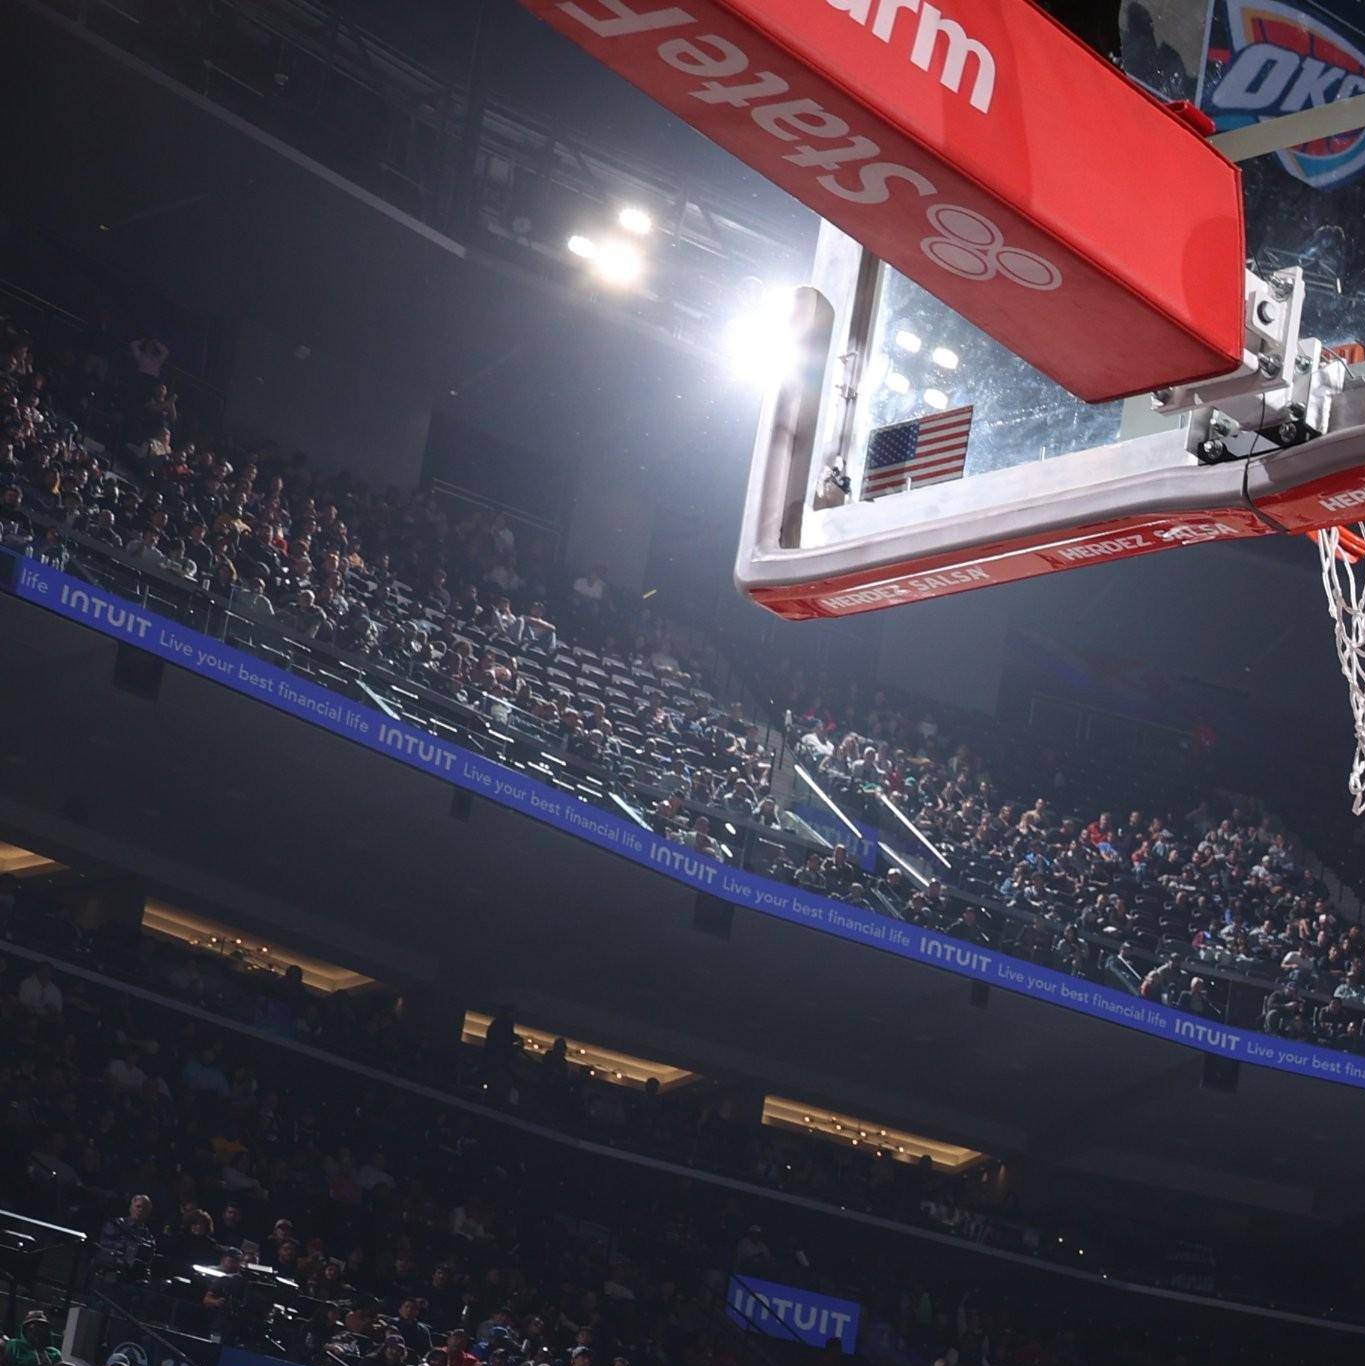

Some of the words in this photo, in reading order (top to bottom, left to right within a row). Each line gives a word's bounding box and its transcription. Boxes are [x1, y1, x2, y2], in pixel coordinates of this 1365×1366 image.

[1058, 534, 1154, 561] HERDEZ
[910, 566, 991, 593] SALSA
[21, 568, 49, 595] life
[61, 585, 152, 638] INTUIT
[160, 630, 193, 657] Live
[197, 650, 234, 674] your
[238, 661, 273, 693] best
[278, 681, 343, 721] financial
[346, 711, 370, 734] life
[378, 723, 457, 771] INTUIT
[463, 761, 492, 786] Live
[494, 778, 527, 800] your
[531, 791, 561, 817] best
[564, 806, 620, 841] financial
[622, 830, 643, 852] life
[650, 842, 718, 884] INTUIT
[722, 875, 751, 897] Live
[755, 890, 788, 908] your
[792, 898, 824, 920] best
[827, 908, 886, 939] financial
[888, 926, 910, 946] life
[919, 936, 992, 973] INTUIT
[998, 961, 1025, 984] Live
[1027, 975, 1057, 993] your
[1061, 980, 1089, 1003] best
[1092, 993, 1145, 1021] financial
[1147, 1010, 1167, 1028] life
[1174, 1018, 1240, 1051] INTUIT
[1247, 1040, 1274, 1059] Live
[1277, 1051, 1308, 1068] your
[1312, 1054, 1341, 1074] best
[734, 1288, 852, 1339] INTUIT
